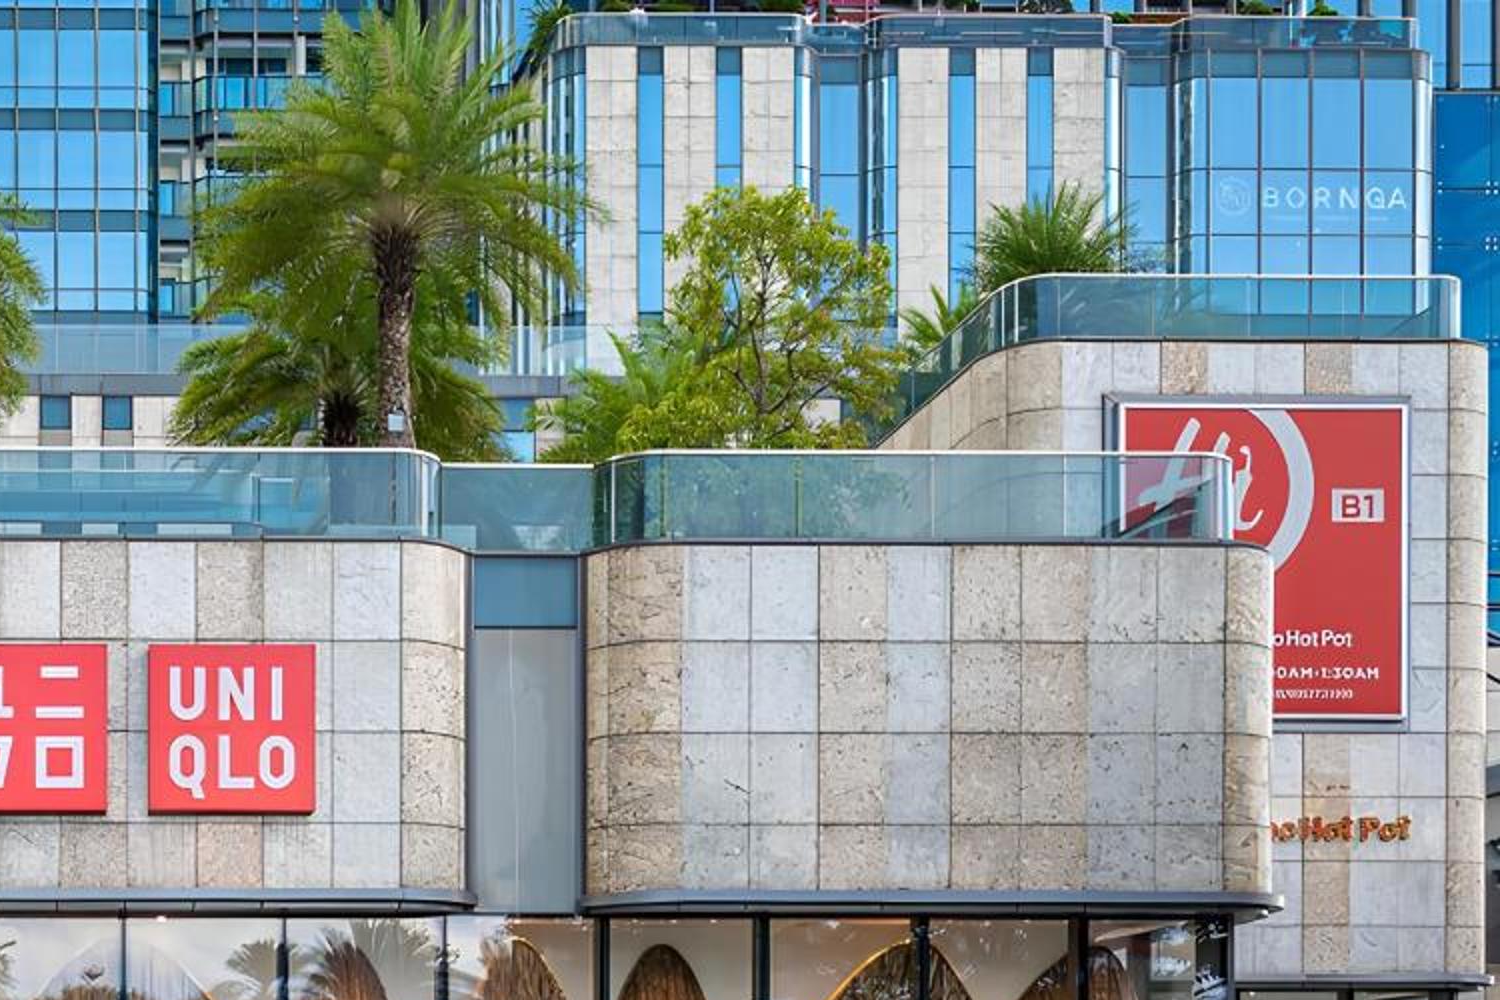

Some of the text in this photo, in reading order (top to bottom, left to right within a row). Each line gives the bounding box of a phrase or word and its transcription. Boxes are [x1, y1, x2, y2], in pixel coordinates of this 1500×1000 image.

[1341, 495, 1375, 518] B1
[1286, 630, 1318, 647] Hot
[1322, 630, 1353, 648] Pot
[169, 666, 283, 721] UNI
[168, 734, 296, 799] QLO
[1359, 815, 1411, 842] Pot
